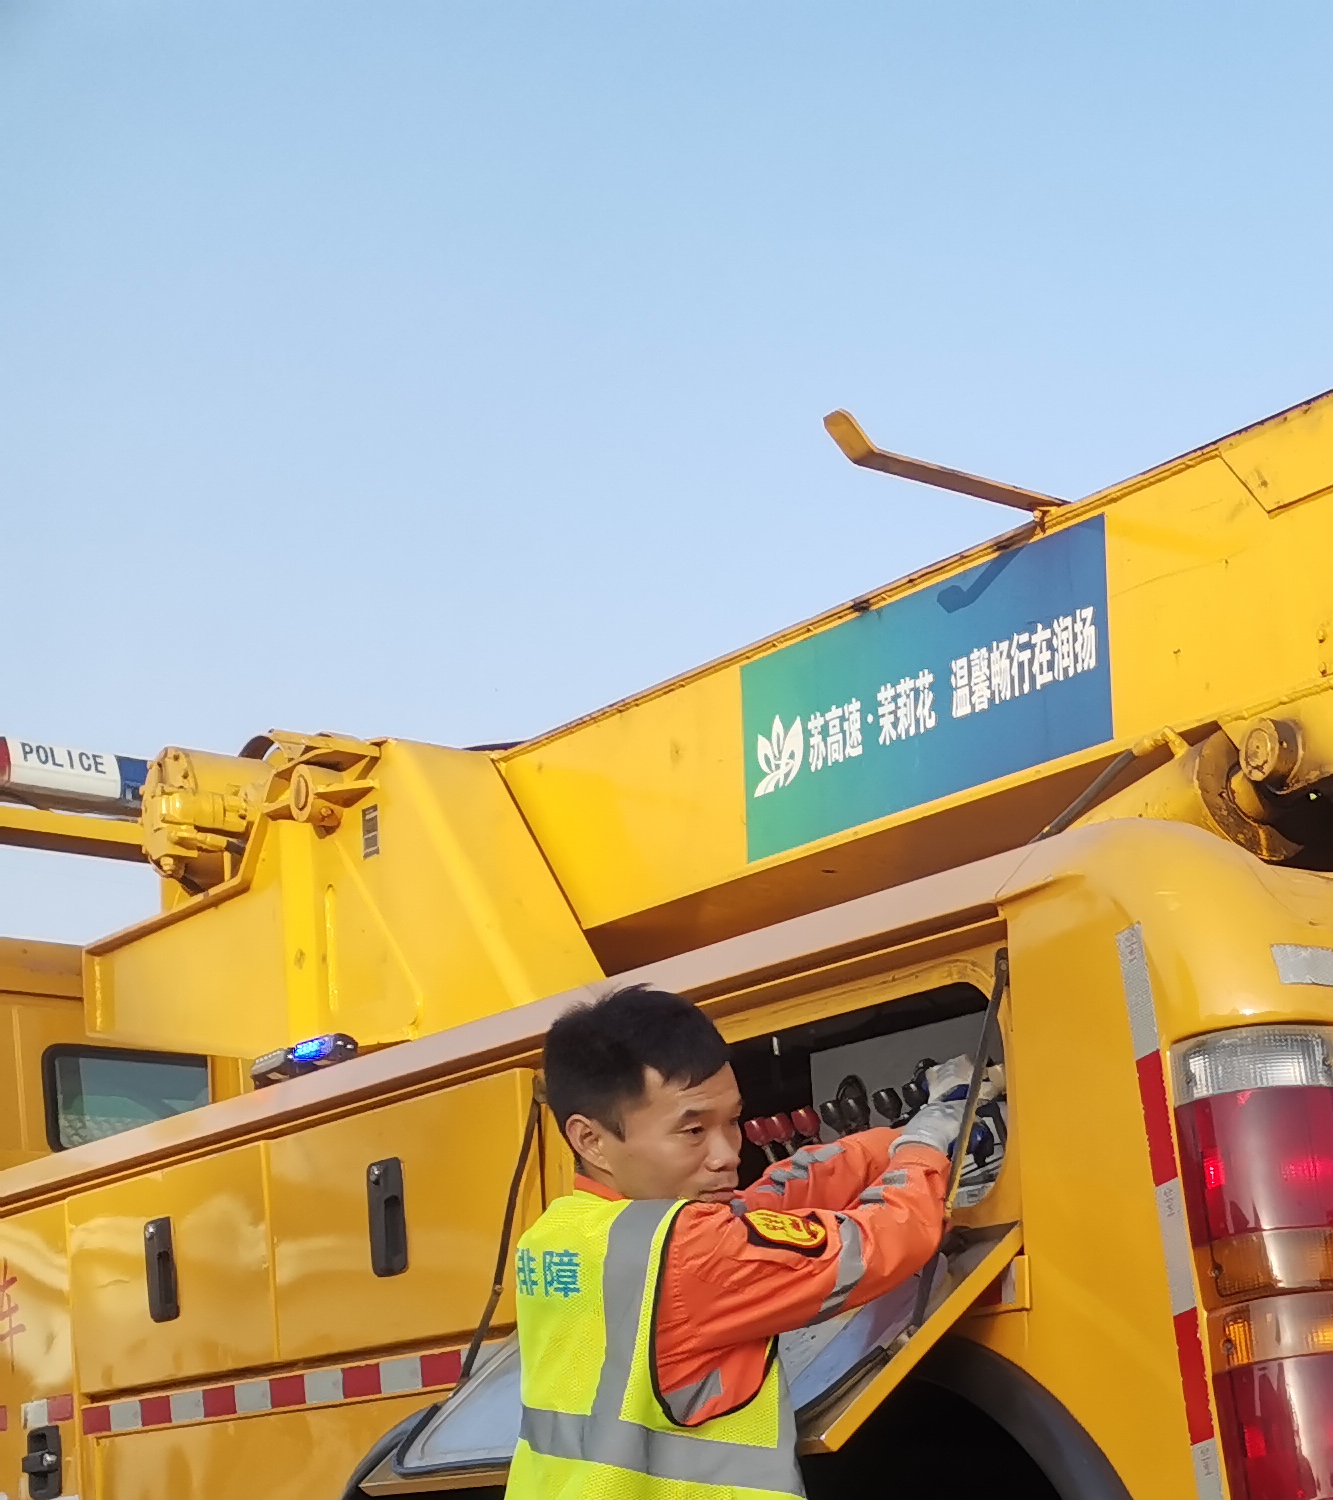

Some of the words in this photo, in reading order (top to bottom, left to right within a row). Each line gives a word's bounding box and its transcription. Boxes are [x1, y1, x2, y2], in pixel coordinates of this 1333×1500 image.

[950, 605, 1097, 719] 温馨畅行在润扬
[20, 741, 107, 775] POLICE
